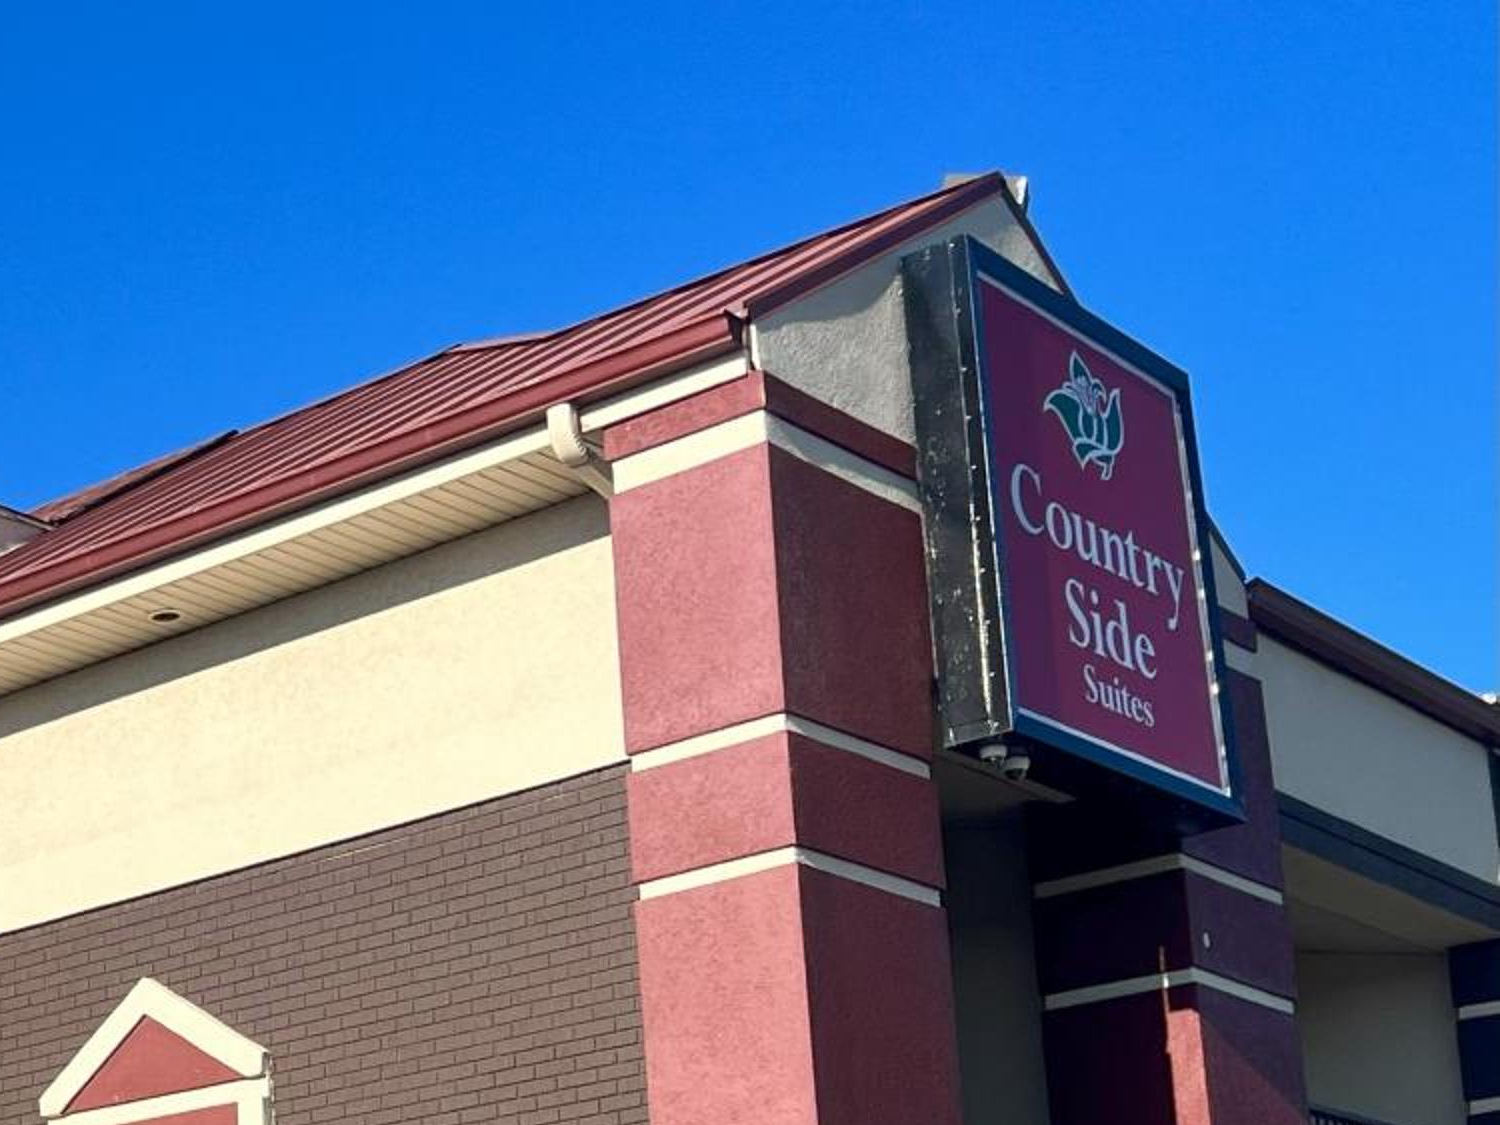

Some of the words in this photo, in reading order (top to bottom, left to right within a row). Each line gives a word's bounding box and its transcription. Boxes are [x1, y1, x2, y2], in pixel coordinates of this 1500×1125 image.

[1009, 462, 1185, 631] Country
[1064, 577, 1158, 681] Side
[1082, 663, 1156, 728] Suites
